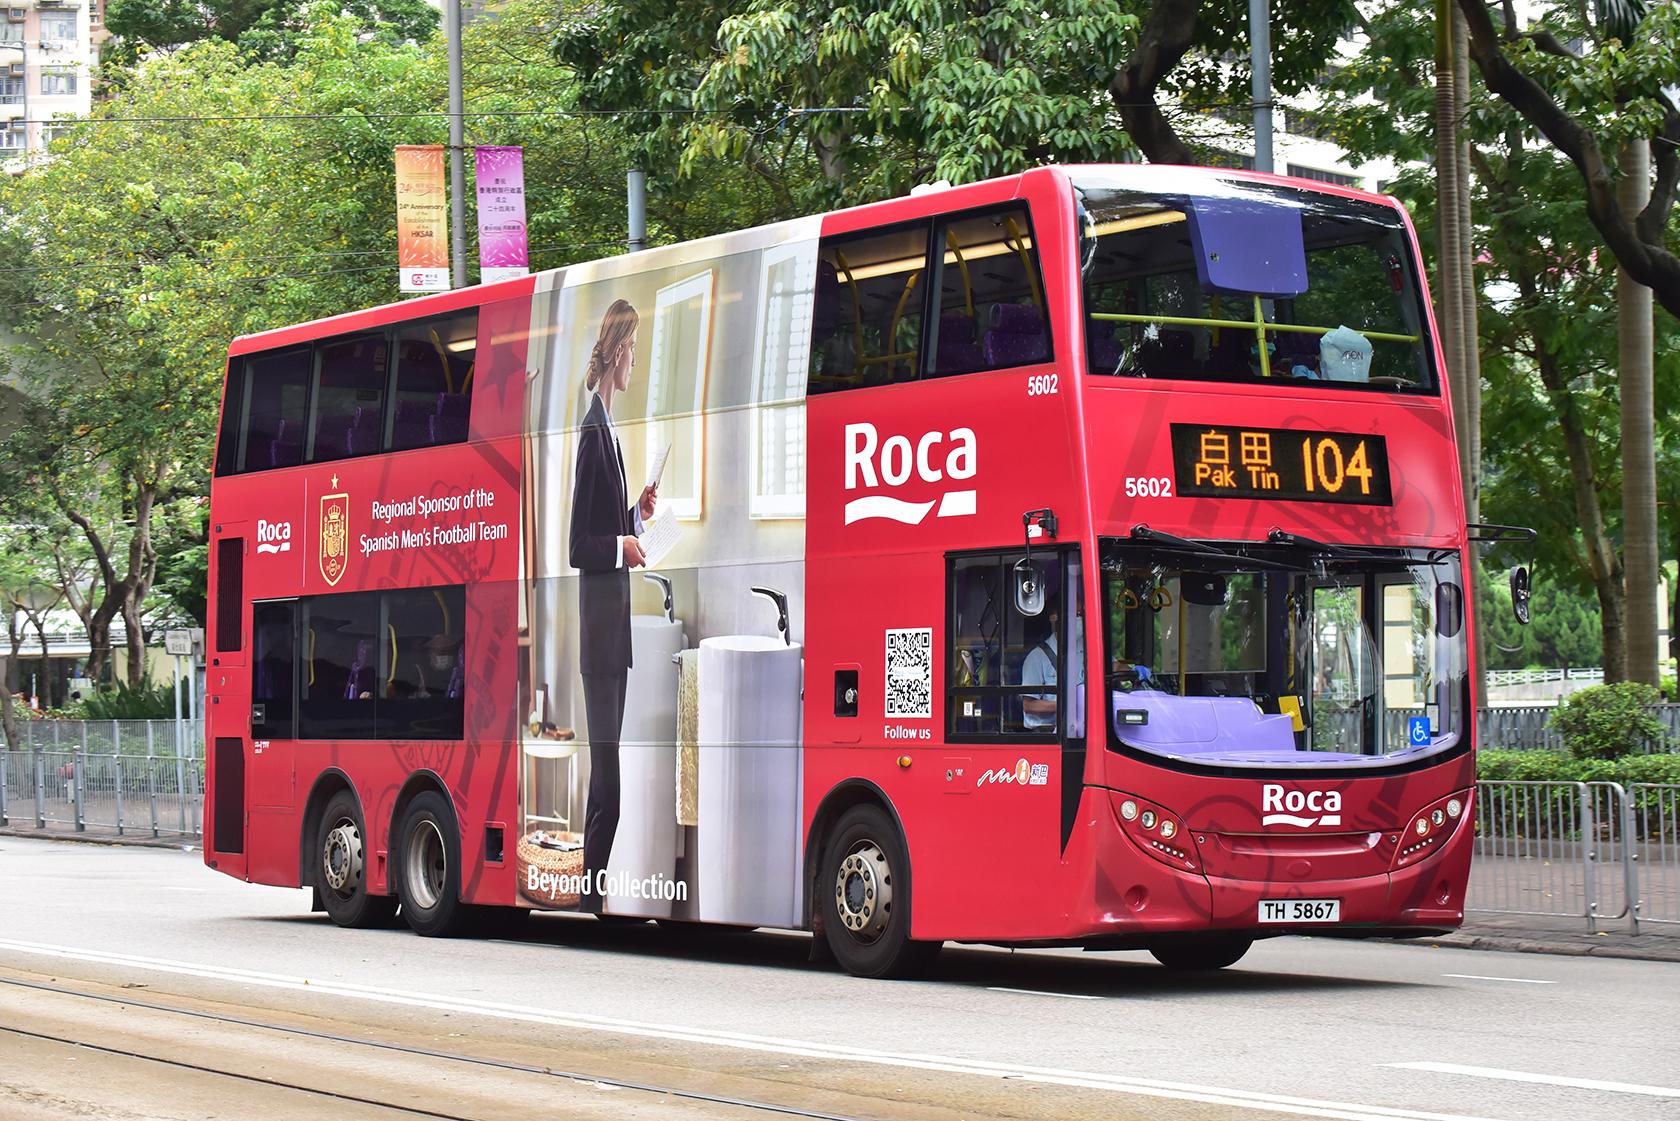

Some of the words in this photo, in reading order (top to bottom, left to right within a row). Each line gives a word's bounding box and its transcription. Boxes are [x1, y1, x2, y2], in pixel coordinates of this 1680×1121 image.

[1027, 373, 1059, 397] 5602
[844, 422, 978, 491] Roca
[1200, 429, 1272, 467] 白田
[1195, 463, 1237, 489] Pak
[1246, 465, 1280, 491] Tin
[1302, 436, 1374, 495] 104
[1125, 477, 1173, 498] 5602
[371, 496, 417, 526] Regional
[417, 494, 463, 521] Sponsor
[463, 488, 476, 511] of
[475, 487, 495, 509] the
[257, 518, 291, 543] Roca
[359, 530, 400, 558] Spanish
[432, 521, 477, 547] Football
[477, 521, 508, 542] Team
[884, 724, 918, 740] Follow
[918, 728, 931, 740] us
[1262, 784, 1342, 812] Roca
[527, 864, 592, 900] Beyond
[596, 868, 688, 901] Collection
[1264, 902, 1286, 920] TH
[1293, 902, 1336, 920] 5867
